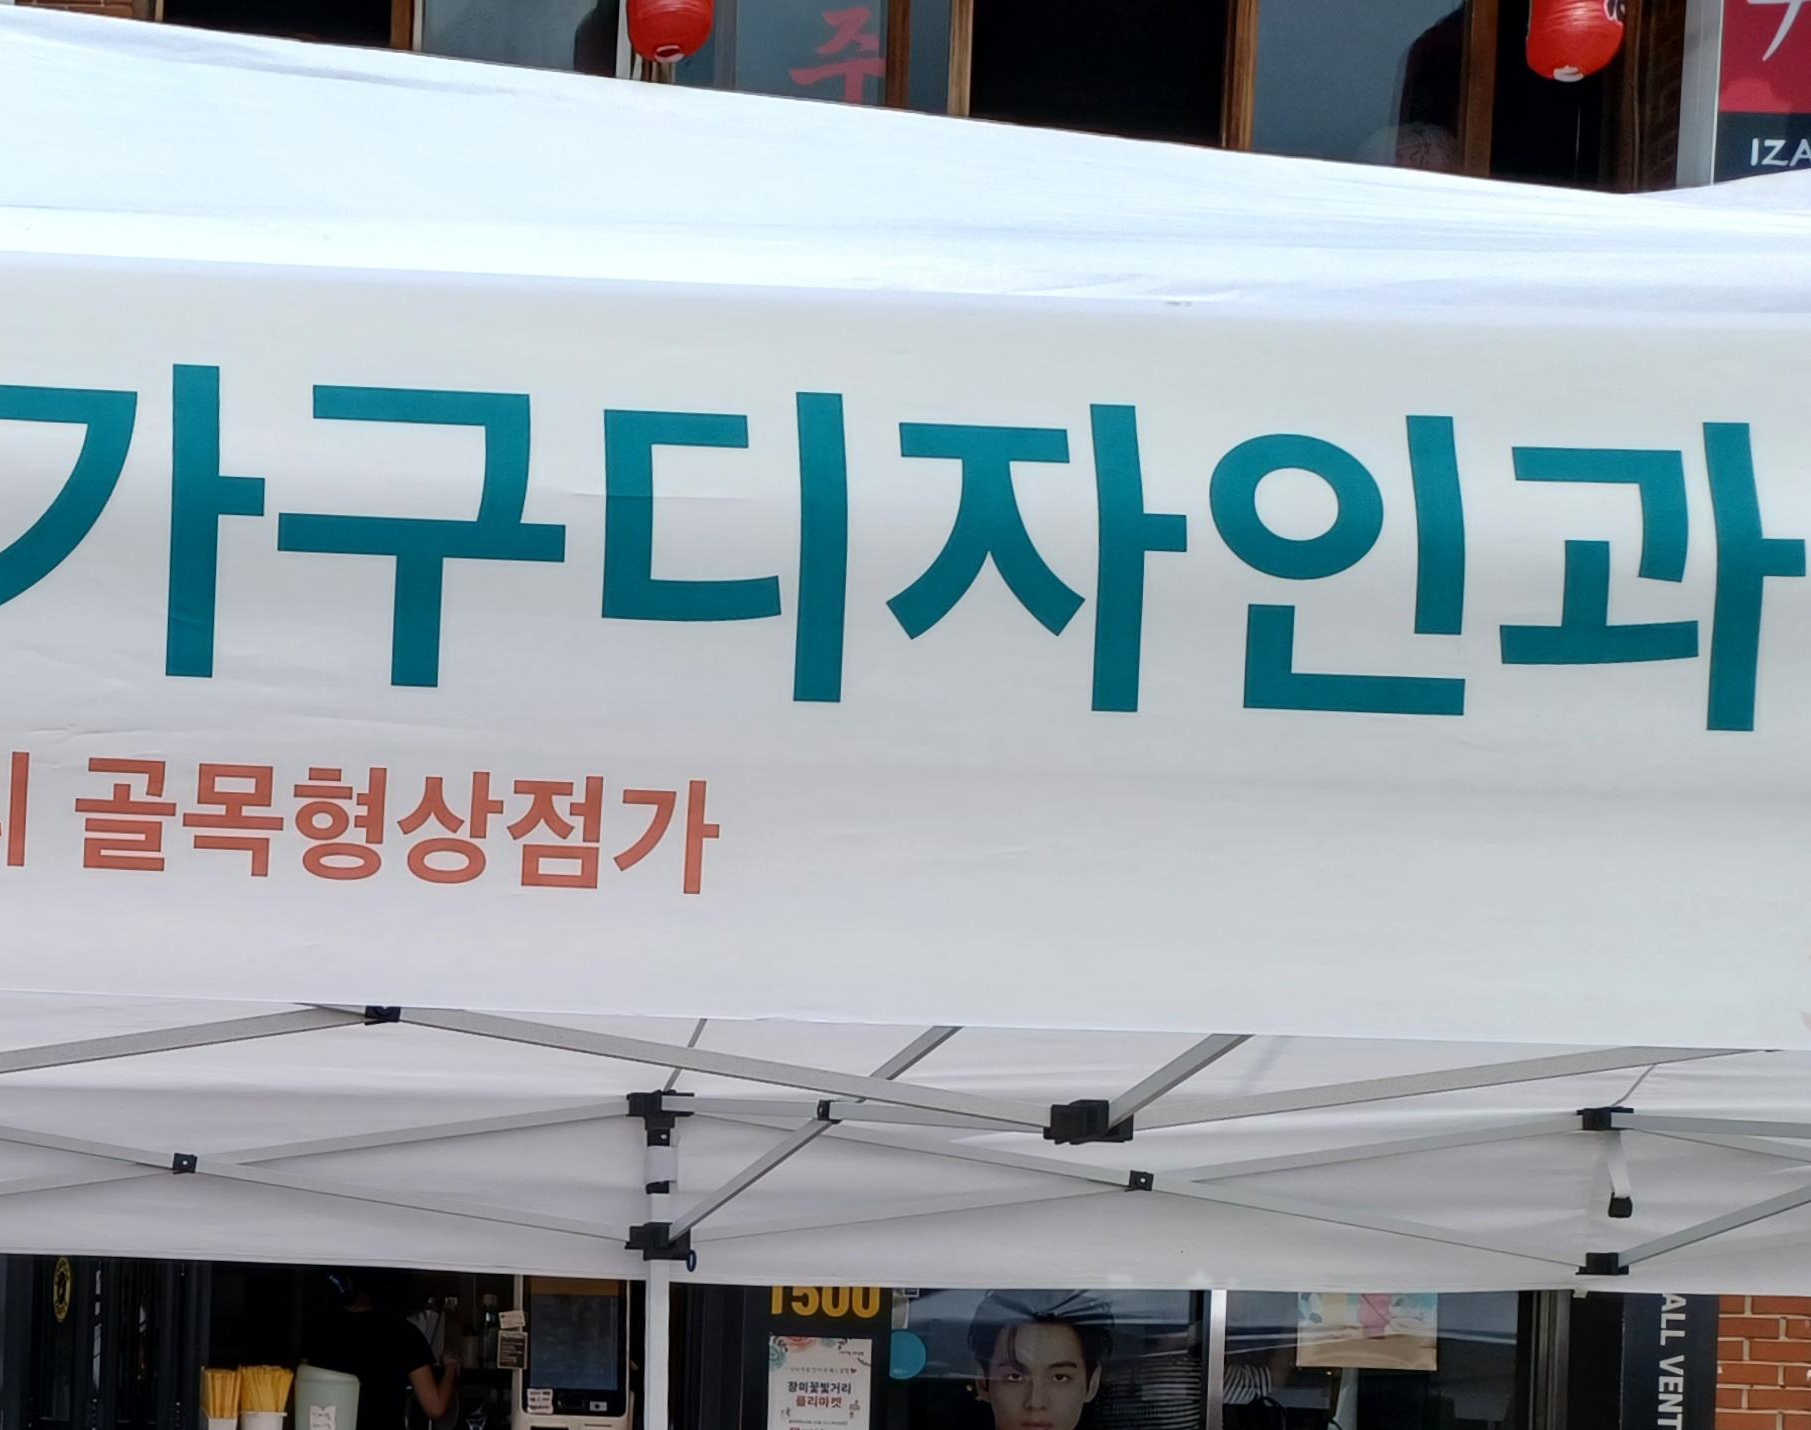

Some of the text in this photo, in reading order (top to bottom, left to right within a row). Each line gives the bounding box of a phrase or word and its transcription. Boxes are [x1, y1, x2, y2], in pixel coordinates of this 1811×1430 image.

[74, 755, 720, 895] 골목형상점가
[1660, 1293, 1686, 1346] ALL
[788, 1381, 851, 1395] 장미꽃빛거리
